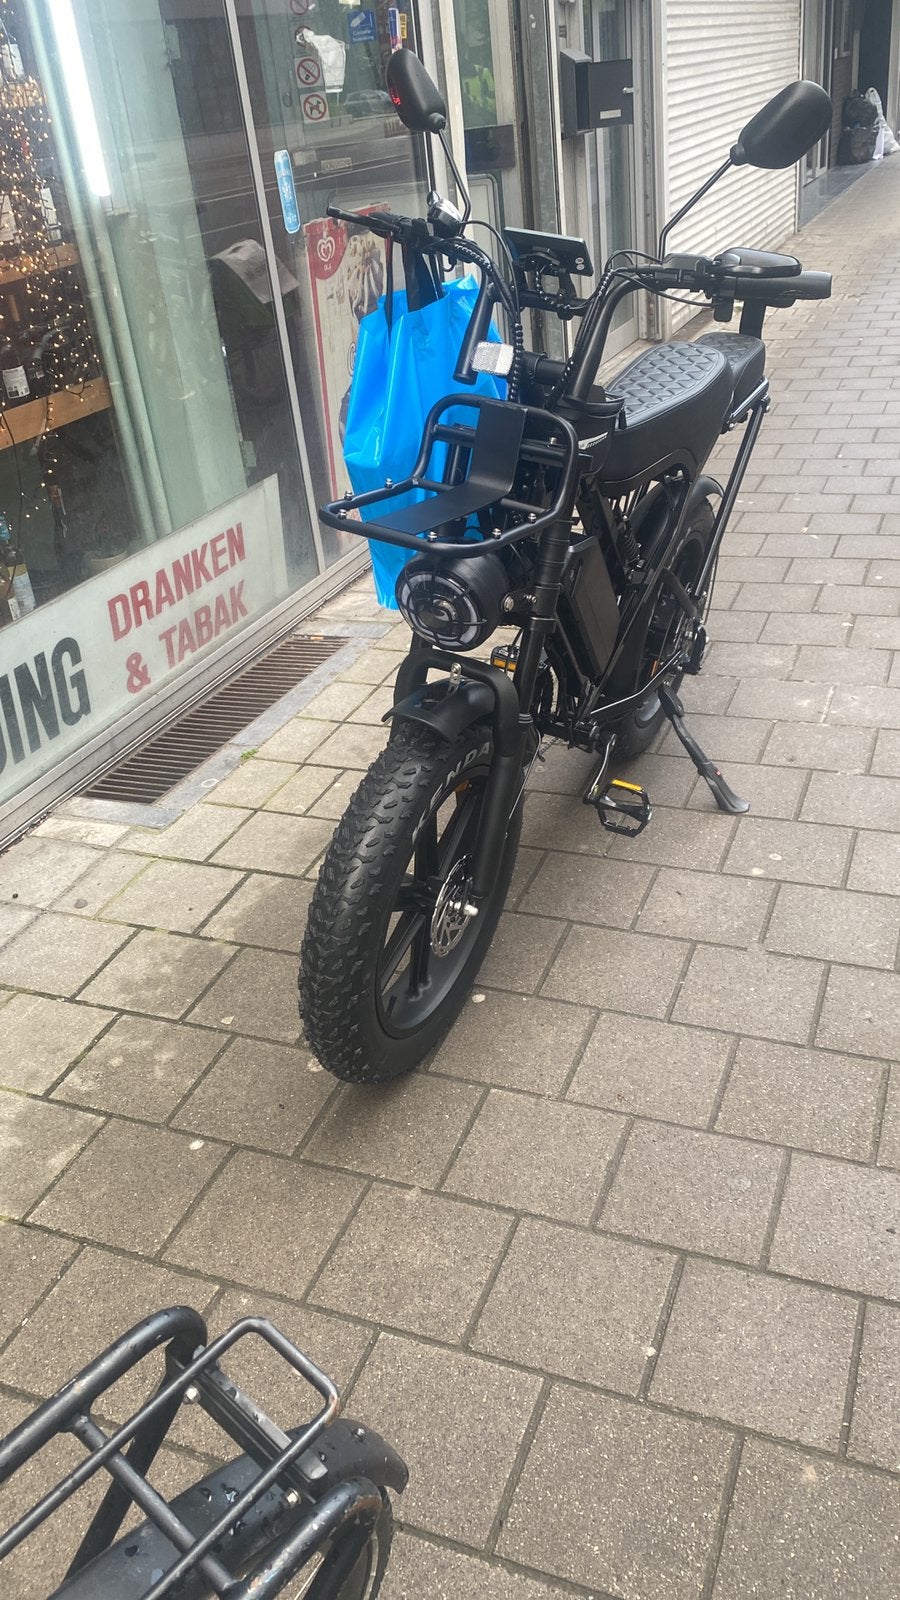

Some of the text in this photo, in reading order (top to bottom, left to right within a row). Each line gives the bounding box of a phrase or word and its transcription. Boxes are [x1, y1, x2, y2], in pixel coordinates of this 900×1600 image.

[108, 523, 246, 641] DRANKEN
[126, 580, 248, 694] & TABAK
[0, 637, 91, 774] ING
